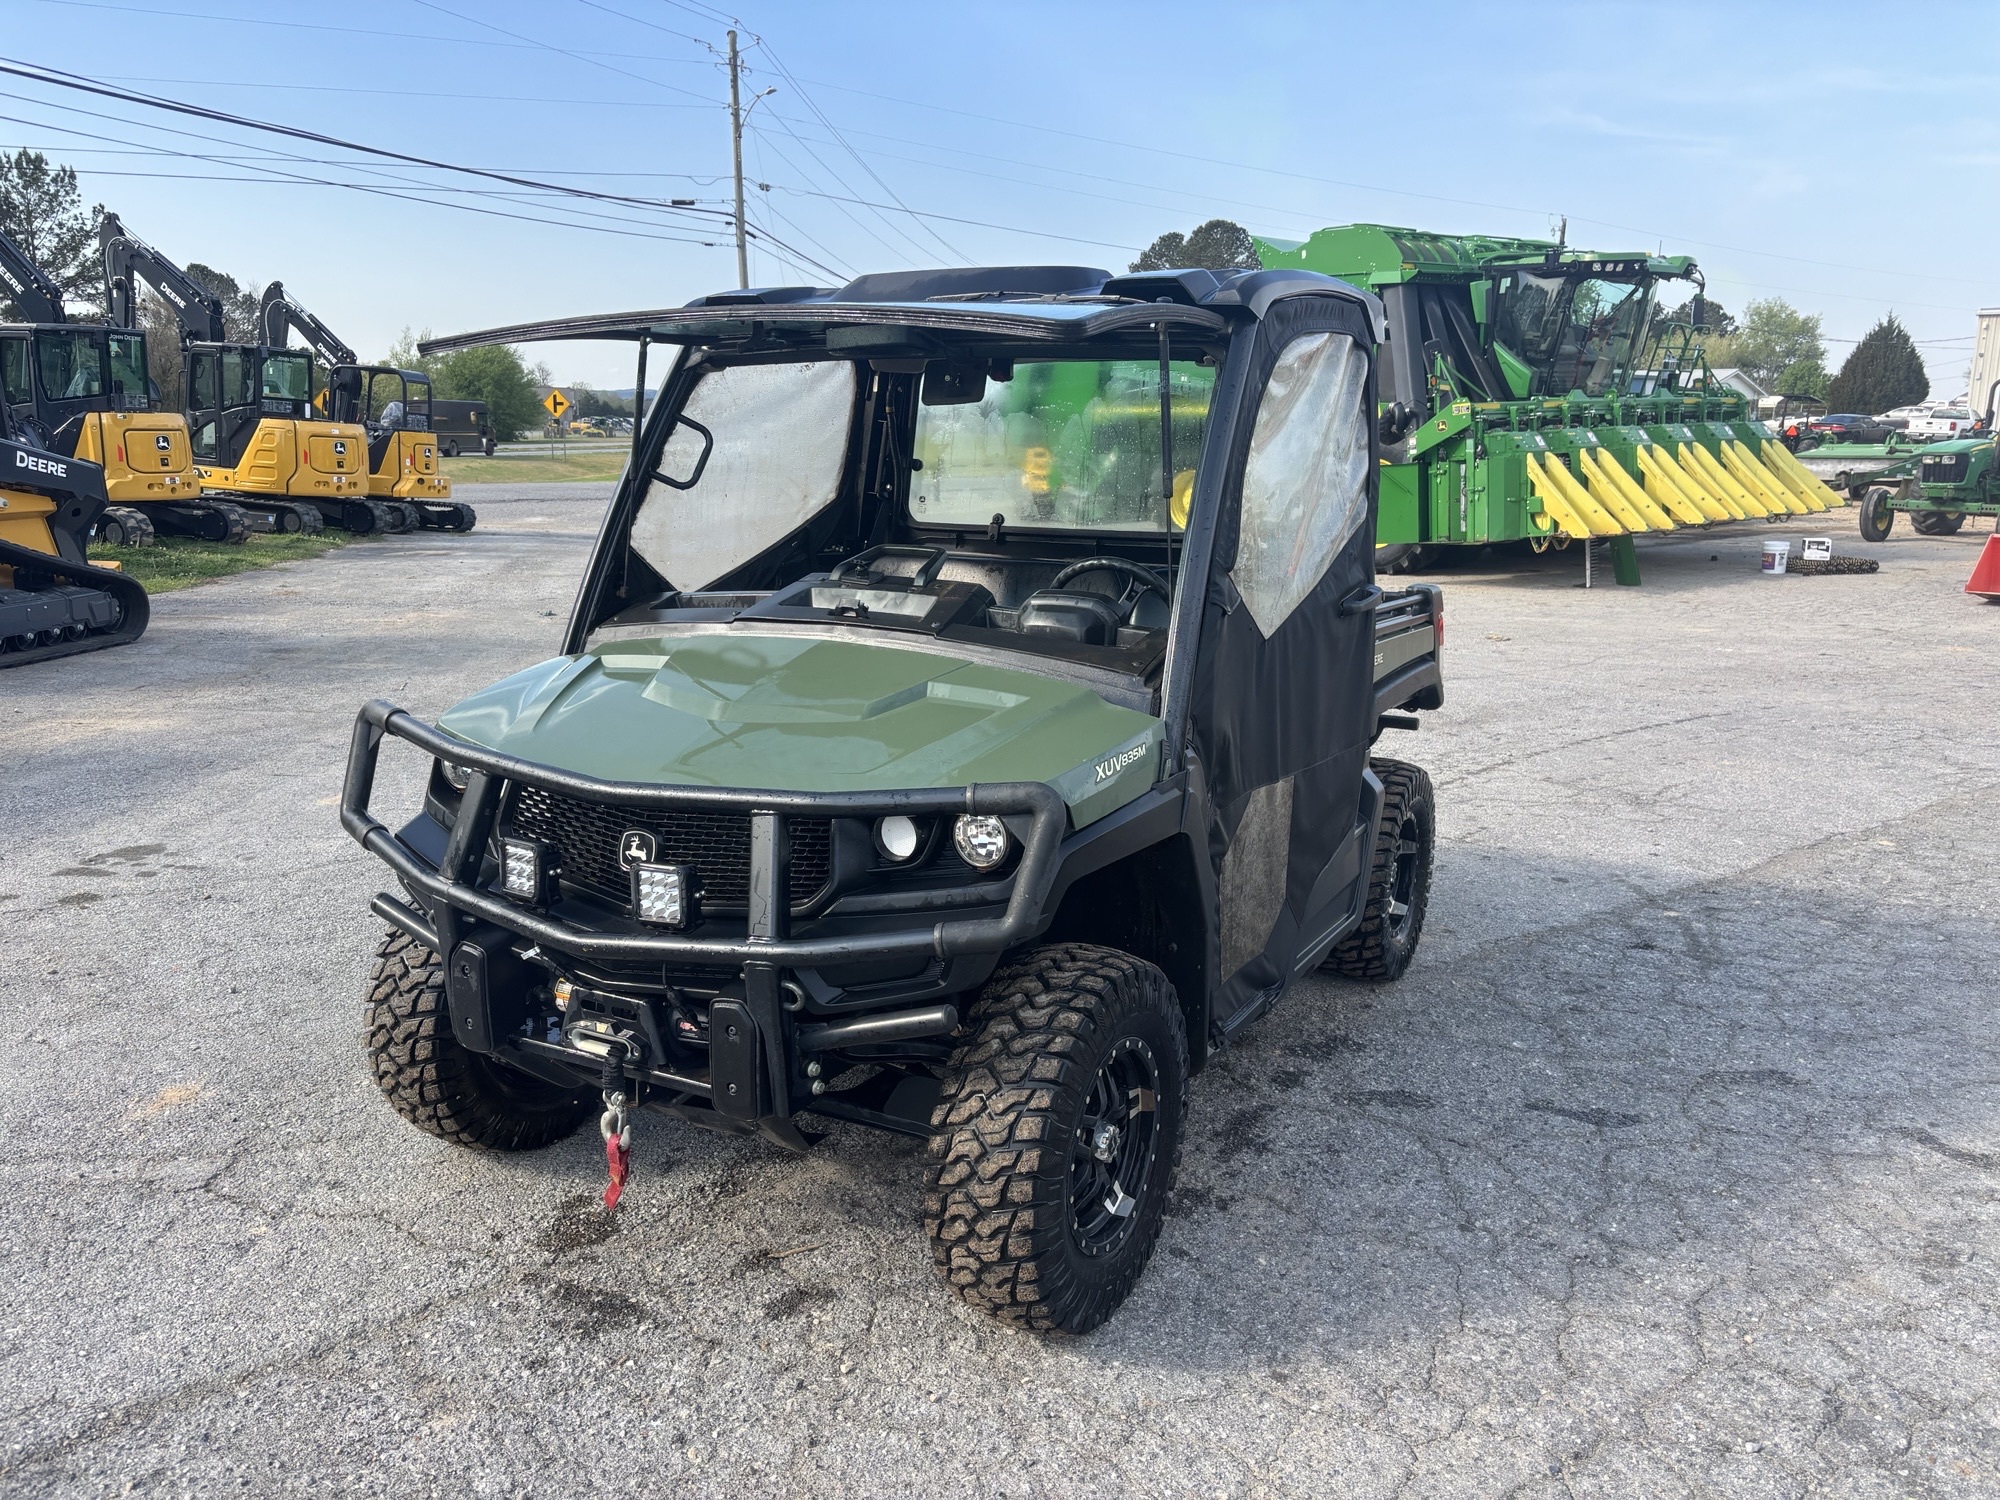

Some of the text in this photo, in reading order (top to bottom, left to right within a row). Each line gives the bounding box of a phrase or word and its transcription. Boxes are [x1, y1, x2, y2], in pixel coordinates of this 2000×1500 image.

[160, 281, 187, 309] DEERE
[317, 342, 338, 365] DEERE
[16, 450, 67, 477] DEERE
[1095, 743, 1147, 783] XUV835M
